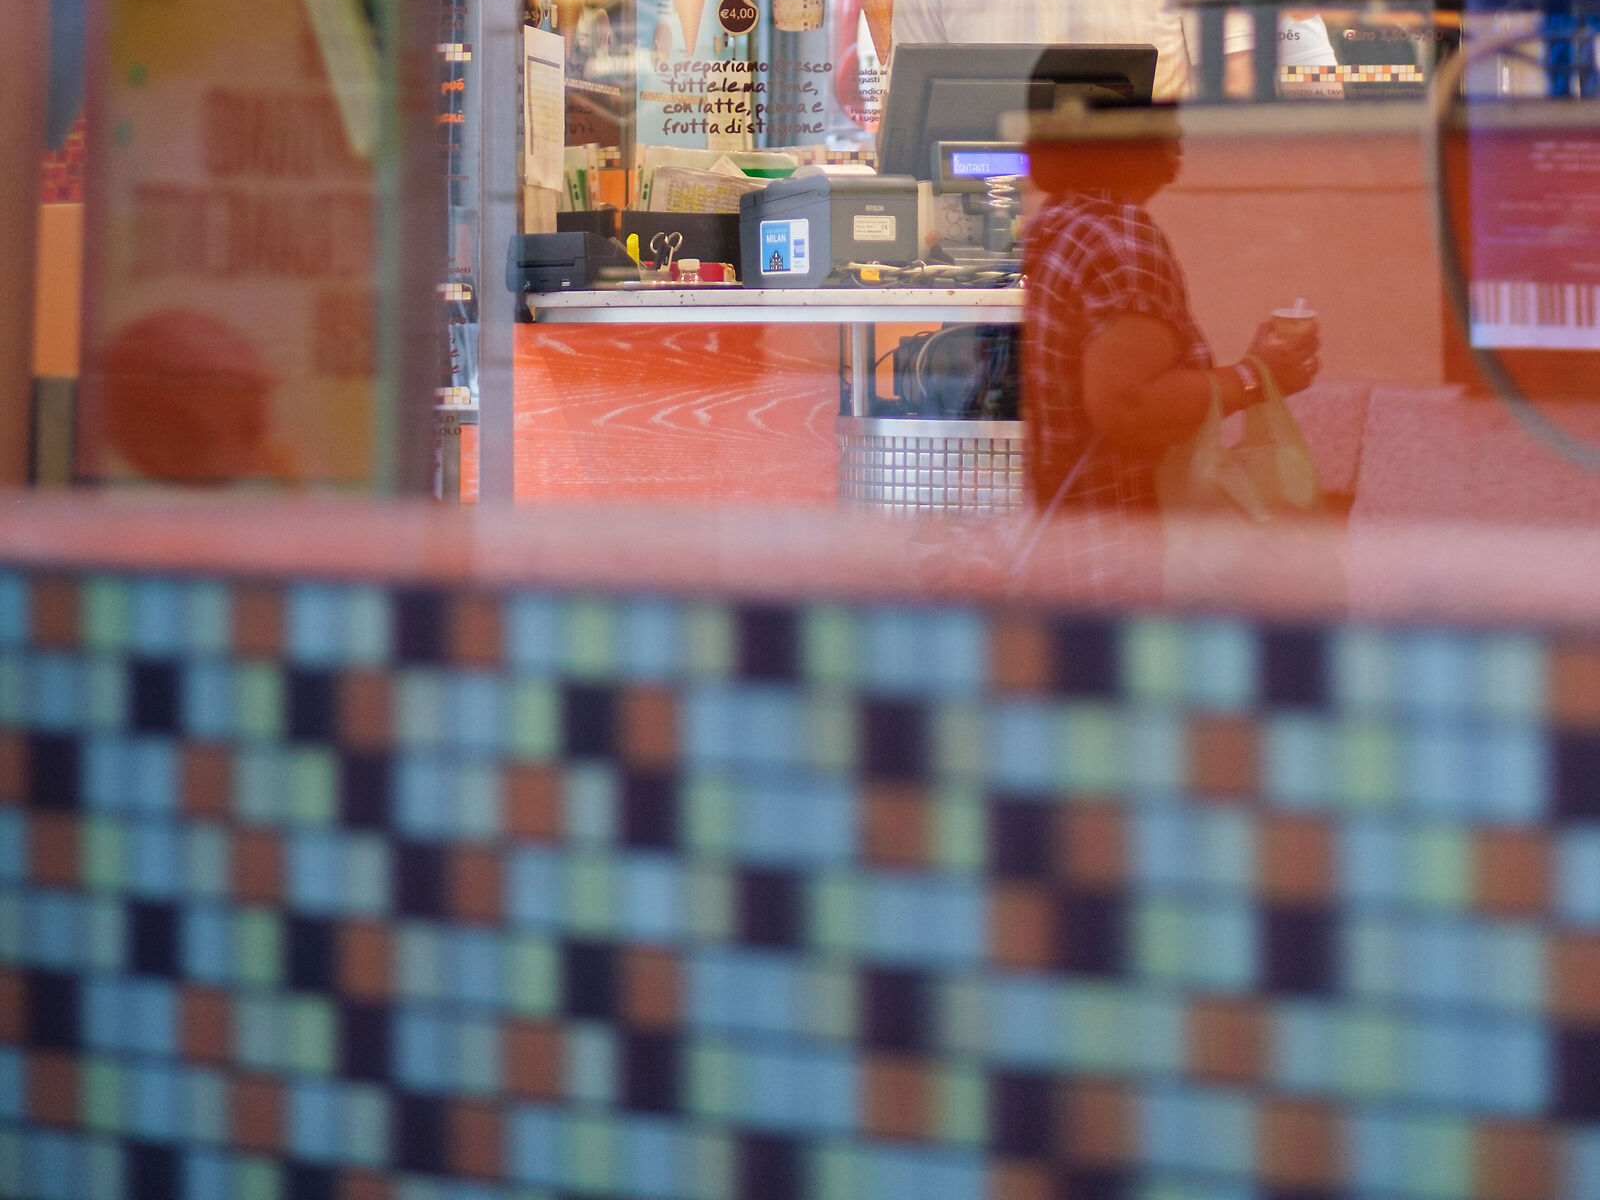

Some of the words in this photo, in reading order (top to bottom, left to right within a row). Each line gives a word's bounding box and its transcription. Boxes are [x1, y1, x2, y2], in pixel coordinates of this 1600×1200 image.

[719, 7, 755, 20] €4,00
[672, 57, 769, 79] prepariamo
[662, 102, 693, 114] con
[660, 117, 720, 136] frutta
[724, 117, 742, 134] di
[953, 163, 990, 174] CONTANTI
[864, 204, 885, 212] EPSON
[766, 233, 787, 243] MILAN
